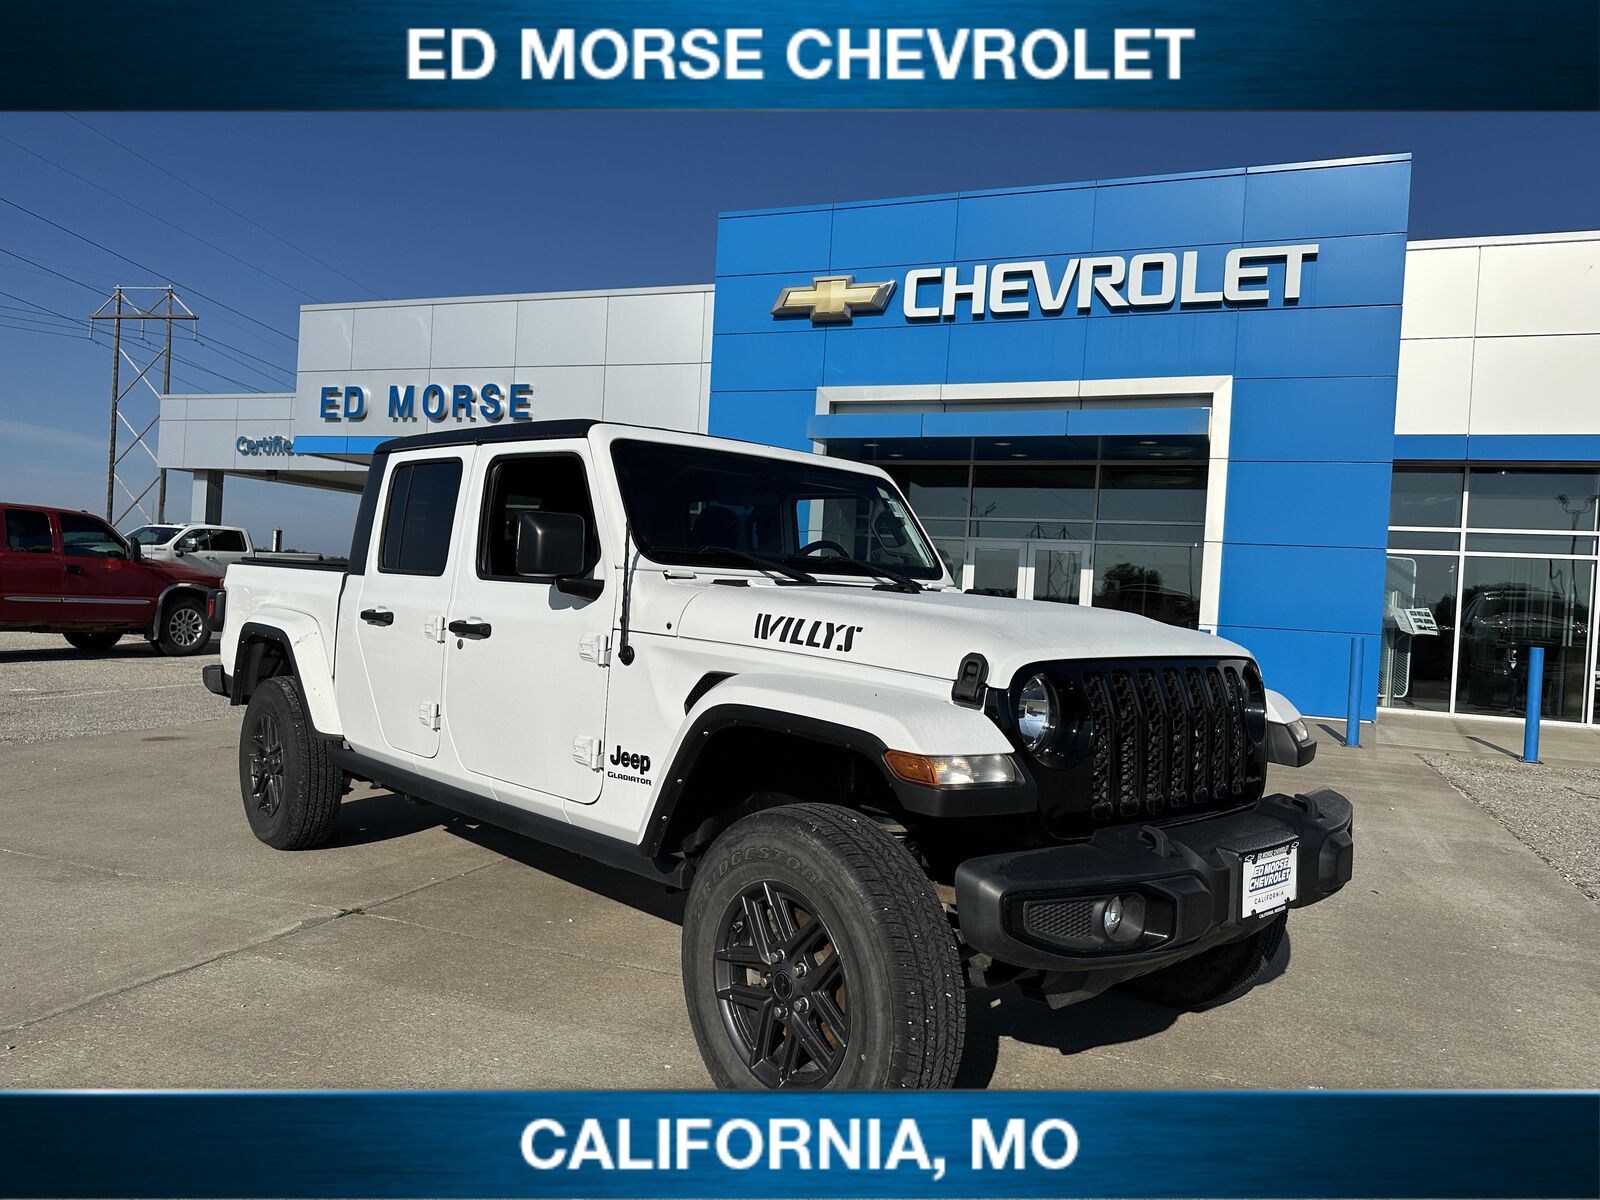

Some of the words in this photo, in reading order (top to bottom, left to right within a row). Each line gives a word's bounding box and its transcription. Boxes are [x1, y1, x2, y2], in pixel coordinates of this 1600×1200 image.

[903, 243, 1320, 319] CHEVROLET
[320, 386, 366, 420] ED
[388, 383, 532, 421] MORSE
[237, 435, 296, 455] Certifie
[753, 612, 864, 653] WILLYS
[609, 744, 651, 775] Jeep
[607, 771, 652, 786] GLADIATOR
[697, 847, 833, 916] RIDGESTONE
[1249, 867, 1292, 892] CHEVROLET
[1253, 864, 1265, 877] ED
[1263, 857, 1290, 875] MORSE
